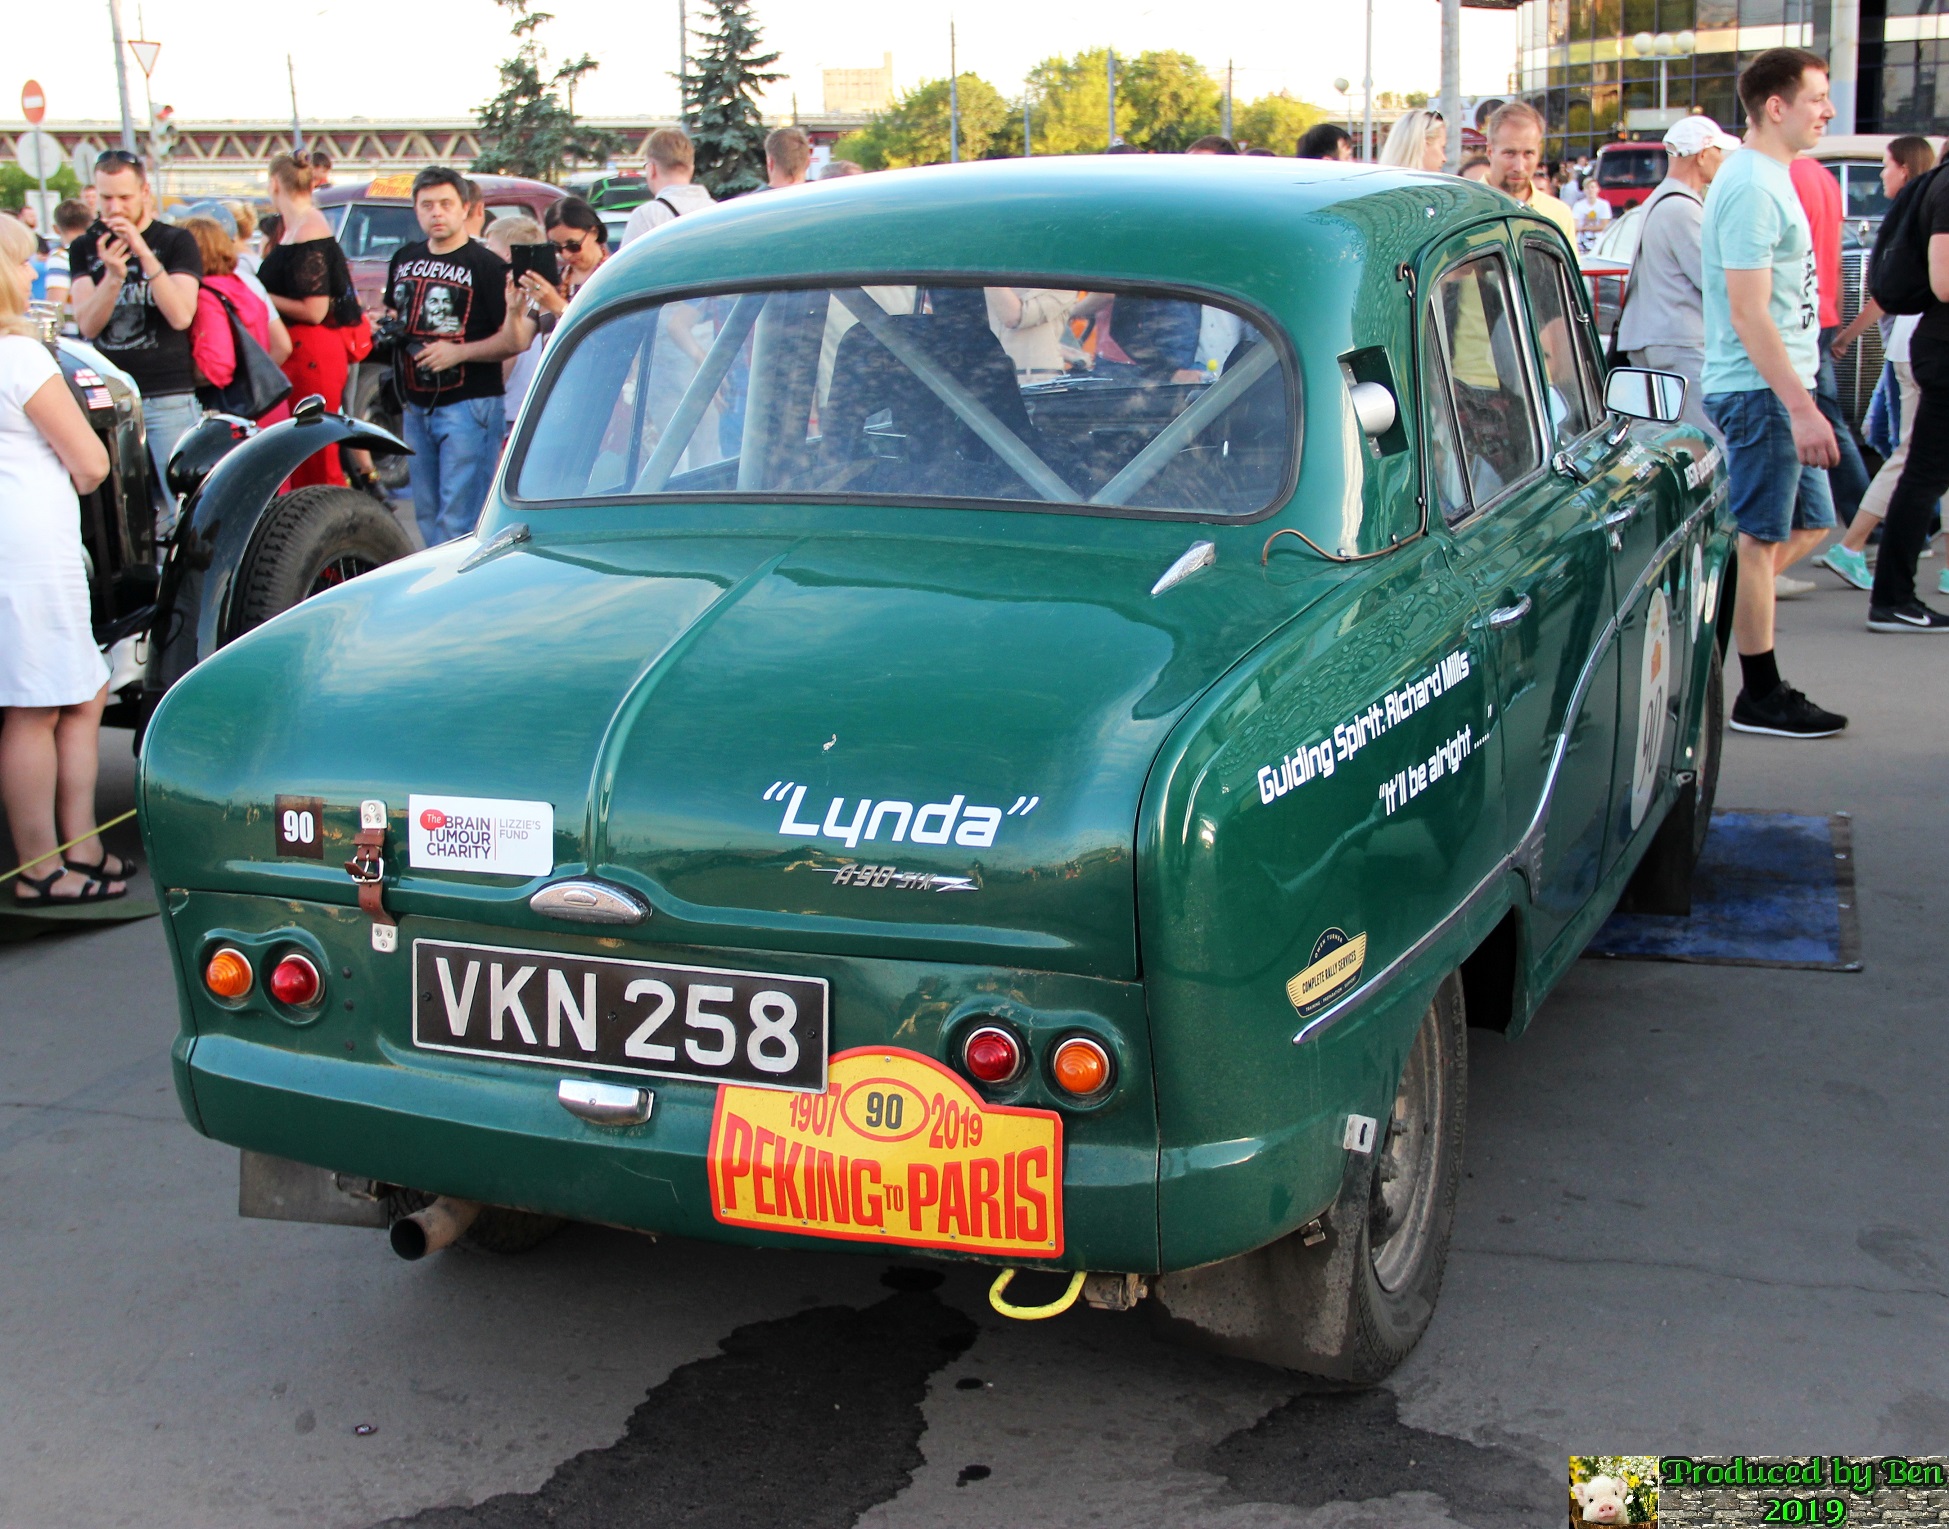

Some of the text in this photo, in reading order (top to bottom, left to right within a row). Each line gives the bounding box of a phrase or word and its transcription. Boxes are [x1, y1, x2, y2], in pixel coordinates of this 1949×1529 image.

[412, 259, 473, 287] GUEVARA
[1257, 650, 1470, 805] Guiding Spirit: Richard Mills
[1408, 765, 1428, 799] be
[1429, 724, 1472, 775] alright
[283, 809, 315, 844] 90
[426, 813, 442, 825] The
[444, 815, 491, 831] BRAIN
[499, 818, 542, 831] LIZZIE'S
[762, 781, 1040, 849] "Lynda"
[426, 843, 491, 860] CHARITY
[427, 829, 491, 845] TUMOUR
[499, 829, 529, 840] FUND
[1302, 950, 1356, 994] COMPLETE RALLY SERVICES
[435, 957, 800, 1073] VKN 258
[789, 1082, 983, 1149] 1907 90 2019
[721, 1111, 1048, 1242] PEKING TO PARIS
